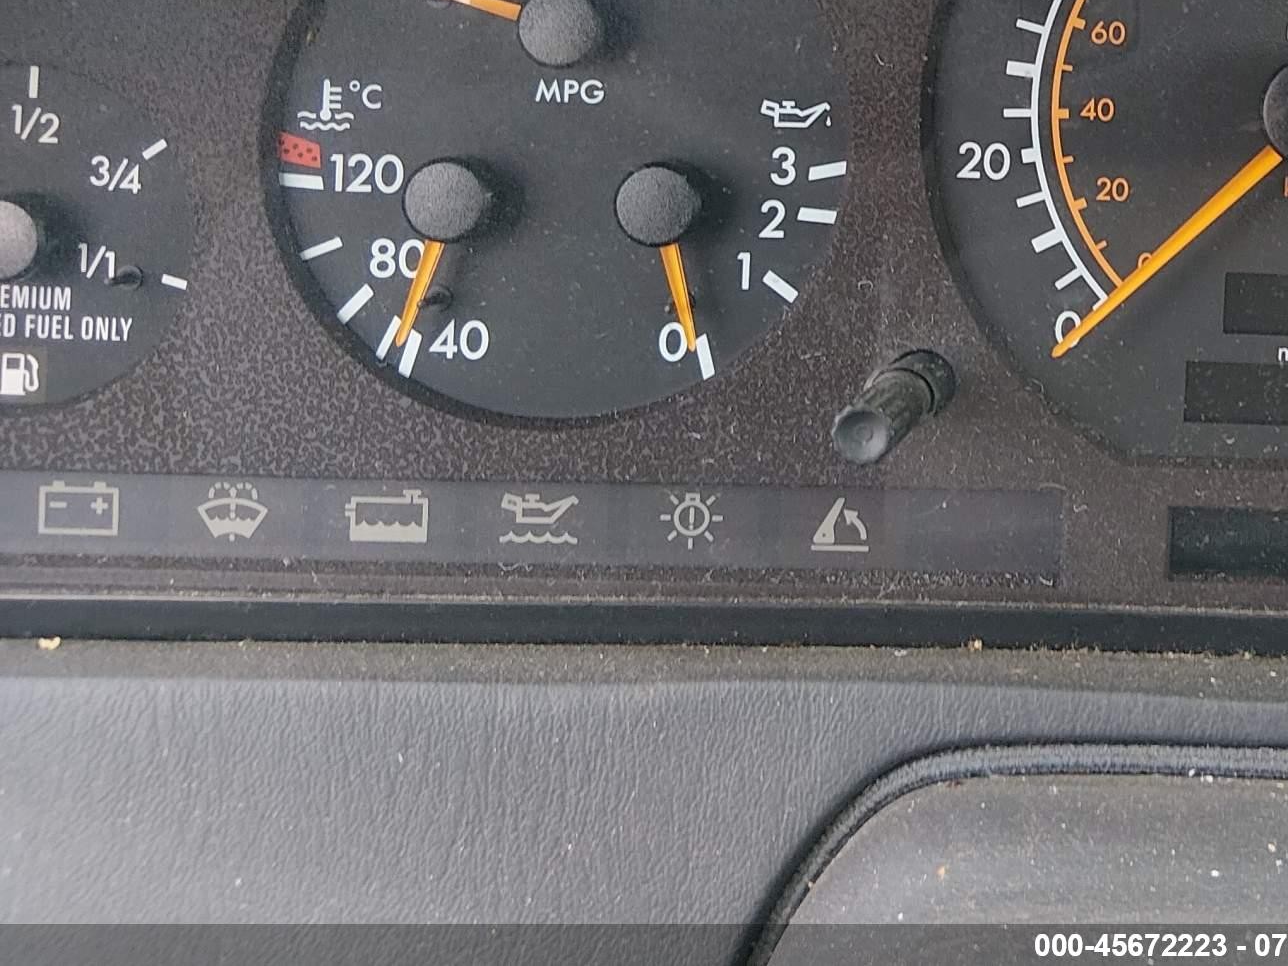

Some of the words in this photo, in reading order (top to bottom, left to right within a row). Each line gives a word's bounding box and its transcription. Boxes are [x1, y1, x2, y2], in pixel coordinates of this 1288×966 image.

[1091, 21, 1125, 44] 60
[536, 79, 604, 103] MPG
[1082, 98, 1114, 121] 40
[11, 104, 60, 144] 1/2
[90, 156, 141, 194] 3/4
[331, 154, 403, 193] 120
[771, 147, 795, 185] 3
[957, 142, 1010, 180] 20
[1098, 177, 1130, 202] 20
[759, 200, 785, 238] 2
[79, 244, 115, 278] 1/1
[370, 238, 424, 278] 80
[738, 253, 750, 290] 1
[25, 315, 73, 339] FUEL
[81, 316, 132, 341] ONLY
[429, 320, 488, 360] 40
[659, 322, 687, 362] 0
